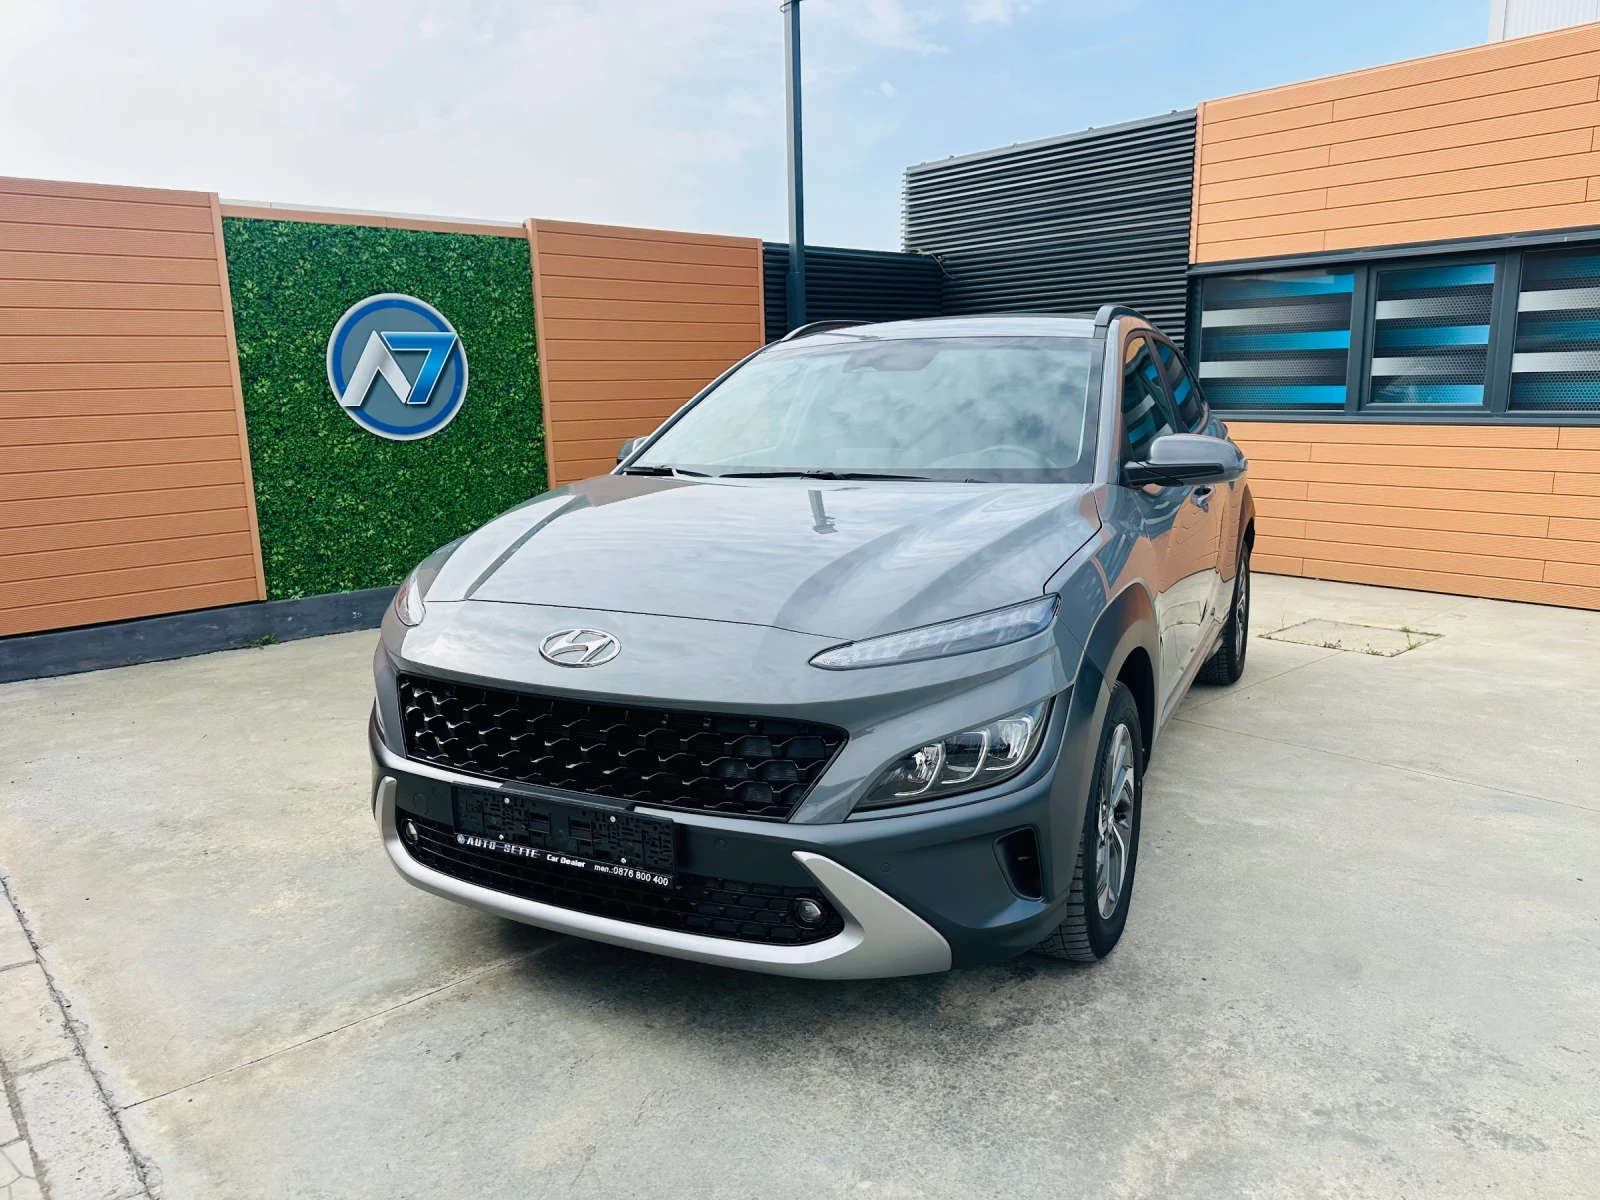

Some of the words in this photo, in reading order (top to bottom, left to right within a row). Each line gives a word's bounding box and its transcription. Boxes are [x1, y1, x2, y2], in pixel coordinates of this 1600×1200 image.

[466, 837, 496, 850] AUTO
[503, 844, 540, 859] SETTE
[546, 854, 559, 863] Car
[560, 856, 586, 868] Dealer
[635, 871, 652, 882] 800
[652, 875, 669, 886] 400
